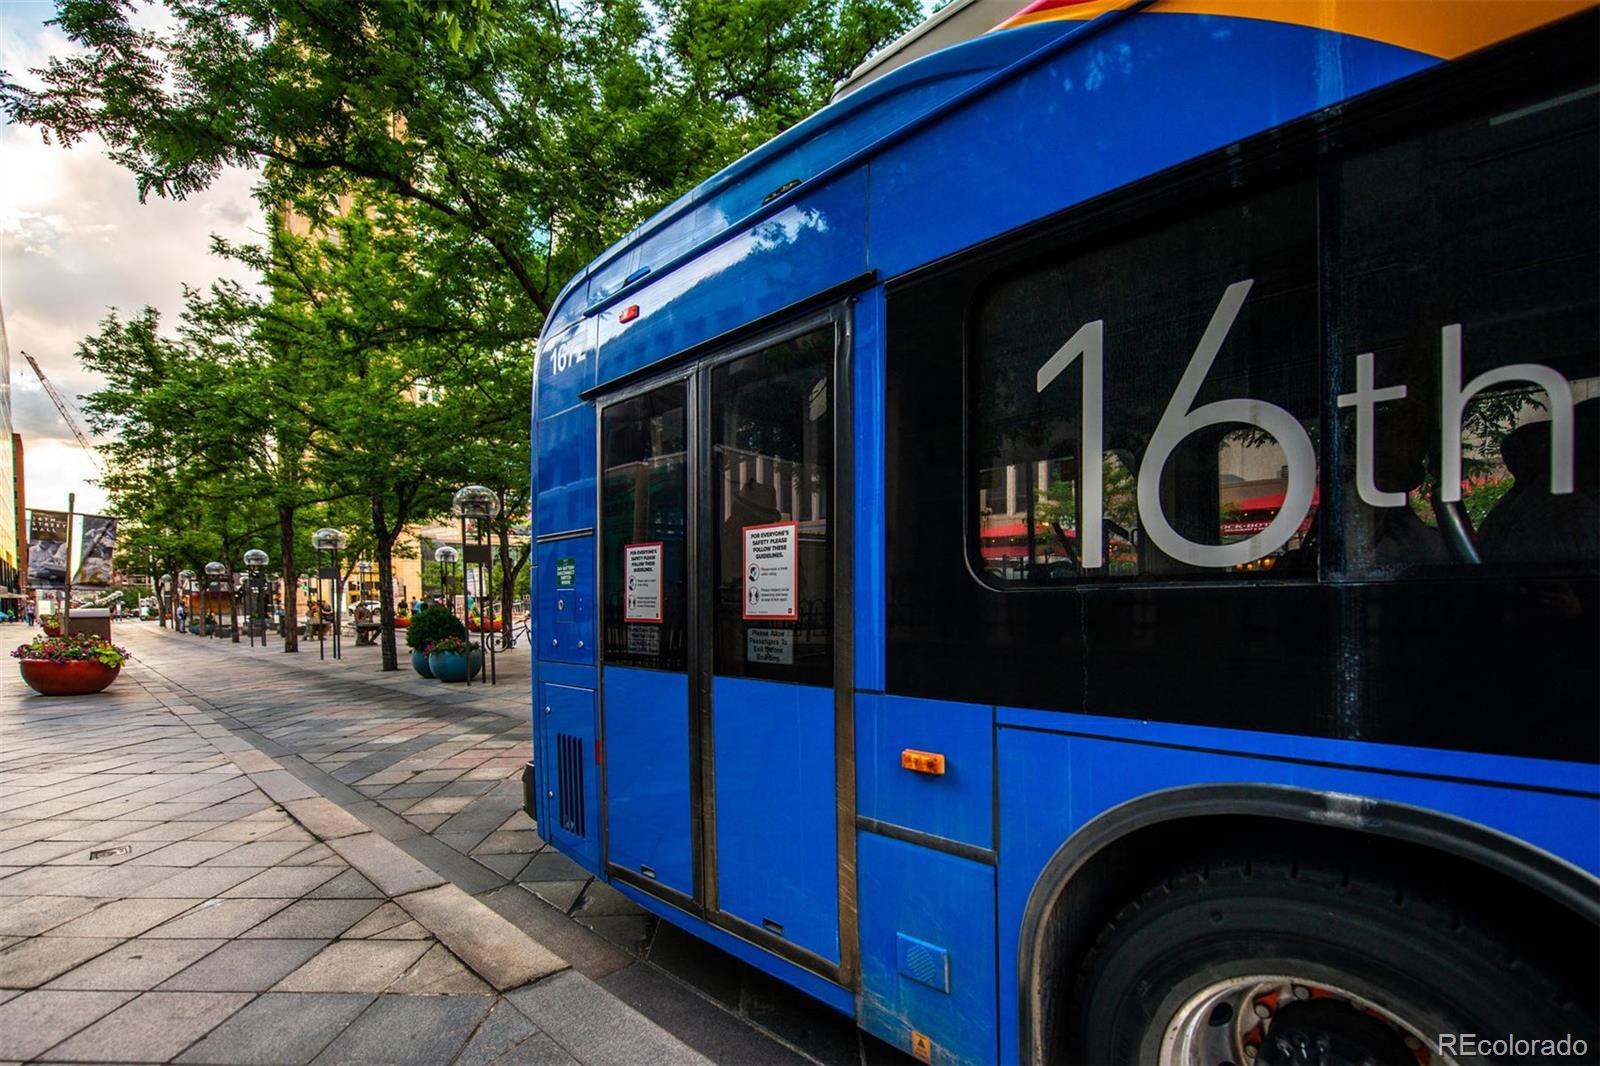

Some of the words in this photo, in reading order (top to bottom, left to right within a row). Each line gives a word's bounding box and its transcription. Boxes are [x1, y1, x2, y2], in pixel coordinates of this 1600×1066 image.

[1036, 278, 1575, 569] 16th
[32, 521, 67, 529] STREET
[760, 530, 789, 538] EVERYONE'S
[749, 637, 780, 646] Passengers
